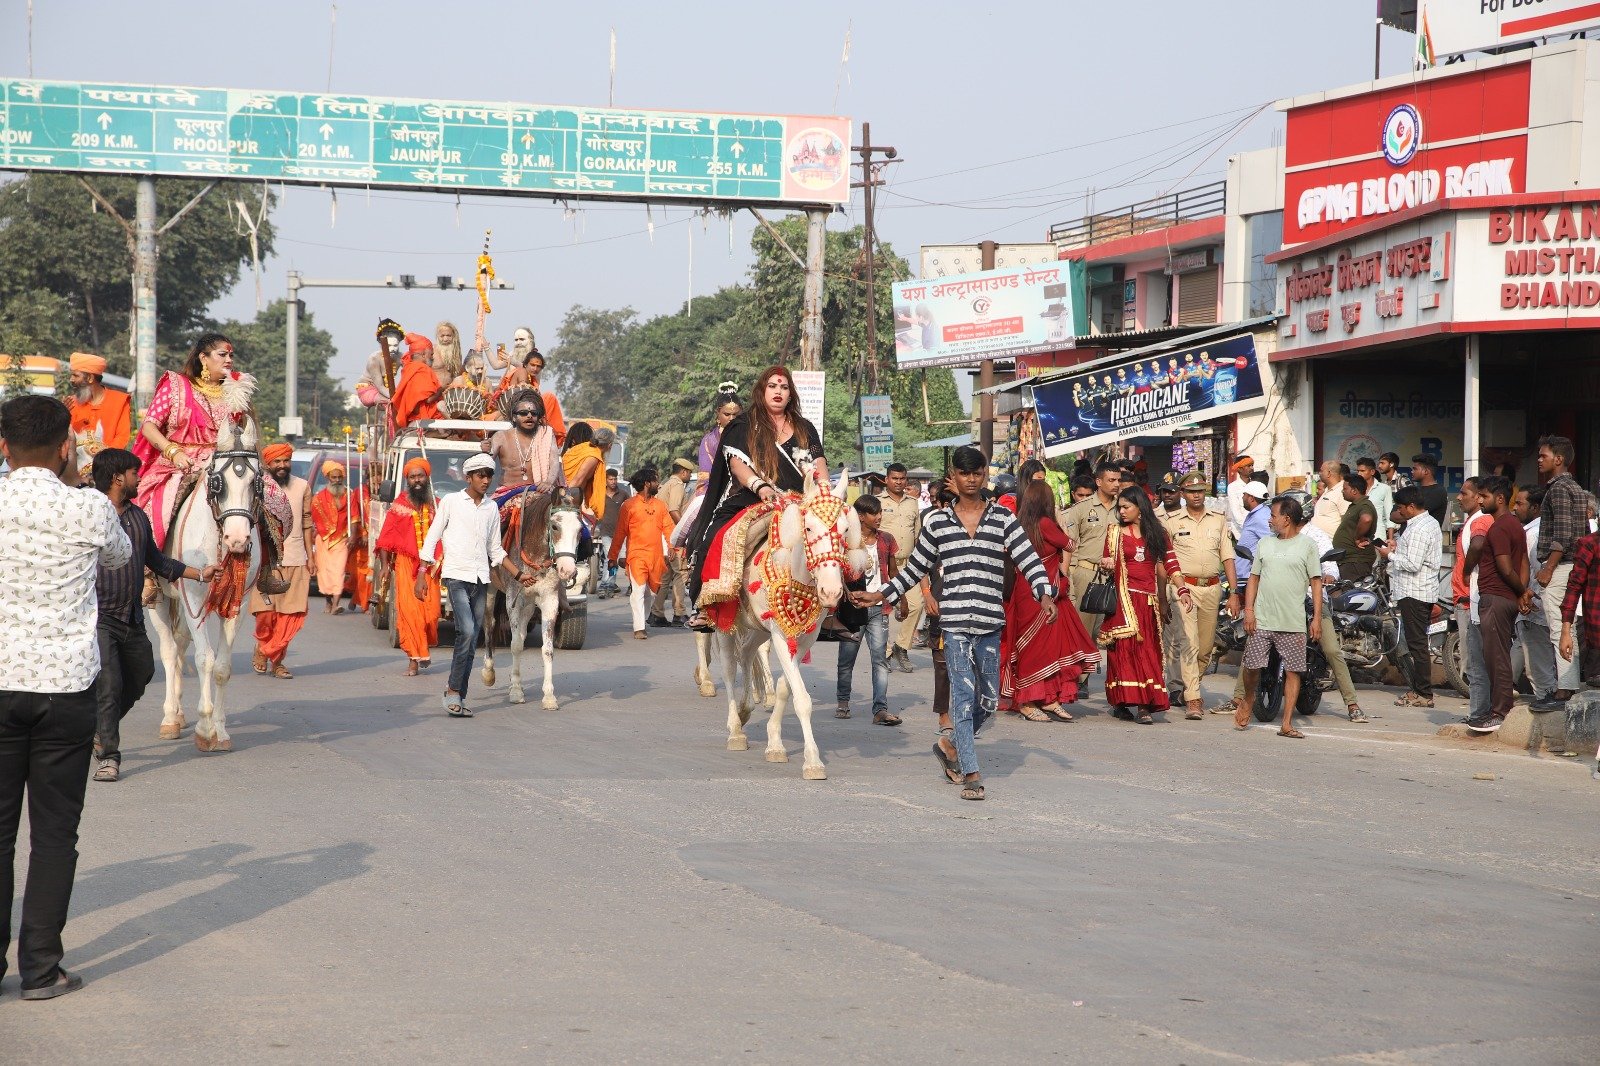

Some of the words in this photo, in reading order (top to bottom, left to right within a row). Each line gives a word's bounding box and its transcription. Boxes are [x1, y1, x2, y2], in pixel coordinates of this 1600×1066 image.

[83, 88, 200, 106] पधारने
[311, 97, 385, 120] लिए
[421, 104, 539, 124] आपका
[174, 118, 226, 137] फूलपुर
[390, 124, 440, 147] जौनपुर
[71, 133, 99, 148] 209
[104, 135, 138, 149] K.M.
[173, 137, 259, 154] PHOOLPUR
[585, 134, 644, 157] गोरखपुर
[298, 143, 318, 158] 20
[321, 144, 354, 160] K.M.
[390, 147, 462, 164] JAUNPUR
[501, 152, 518, 167] 90
[584, 156, 677, 173] GORAKHPUR
[706, 162, 733, 176] 255
[737, 163, 768, 177] K.M.
[1362, 169, 1441, 217] BLOOD
[1445, 158, 1515, 198] BANK
[901, 286, 926, 302] यश
[932, 274, 1020, 300] अल्ट्रासाउण्ड
[1023, 267, 1061, 287] सेन्टर
[1111, 380, 1191, 425] HURRICANE
[1339, 391, 1405, 418] बीकानेर
[1118, 427, 1138, 437] AMAN
[1140, 420, 1169, 432] GENERAL
[1171, 413, 1193, 424] STORE
[866, 445, 892, 455] CNG
